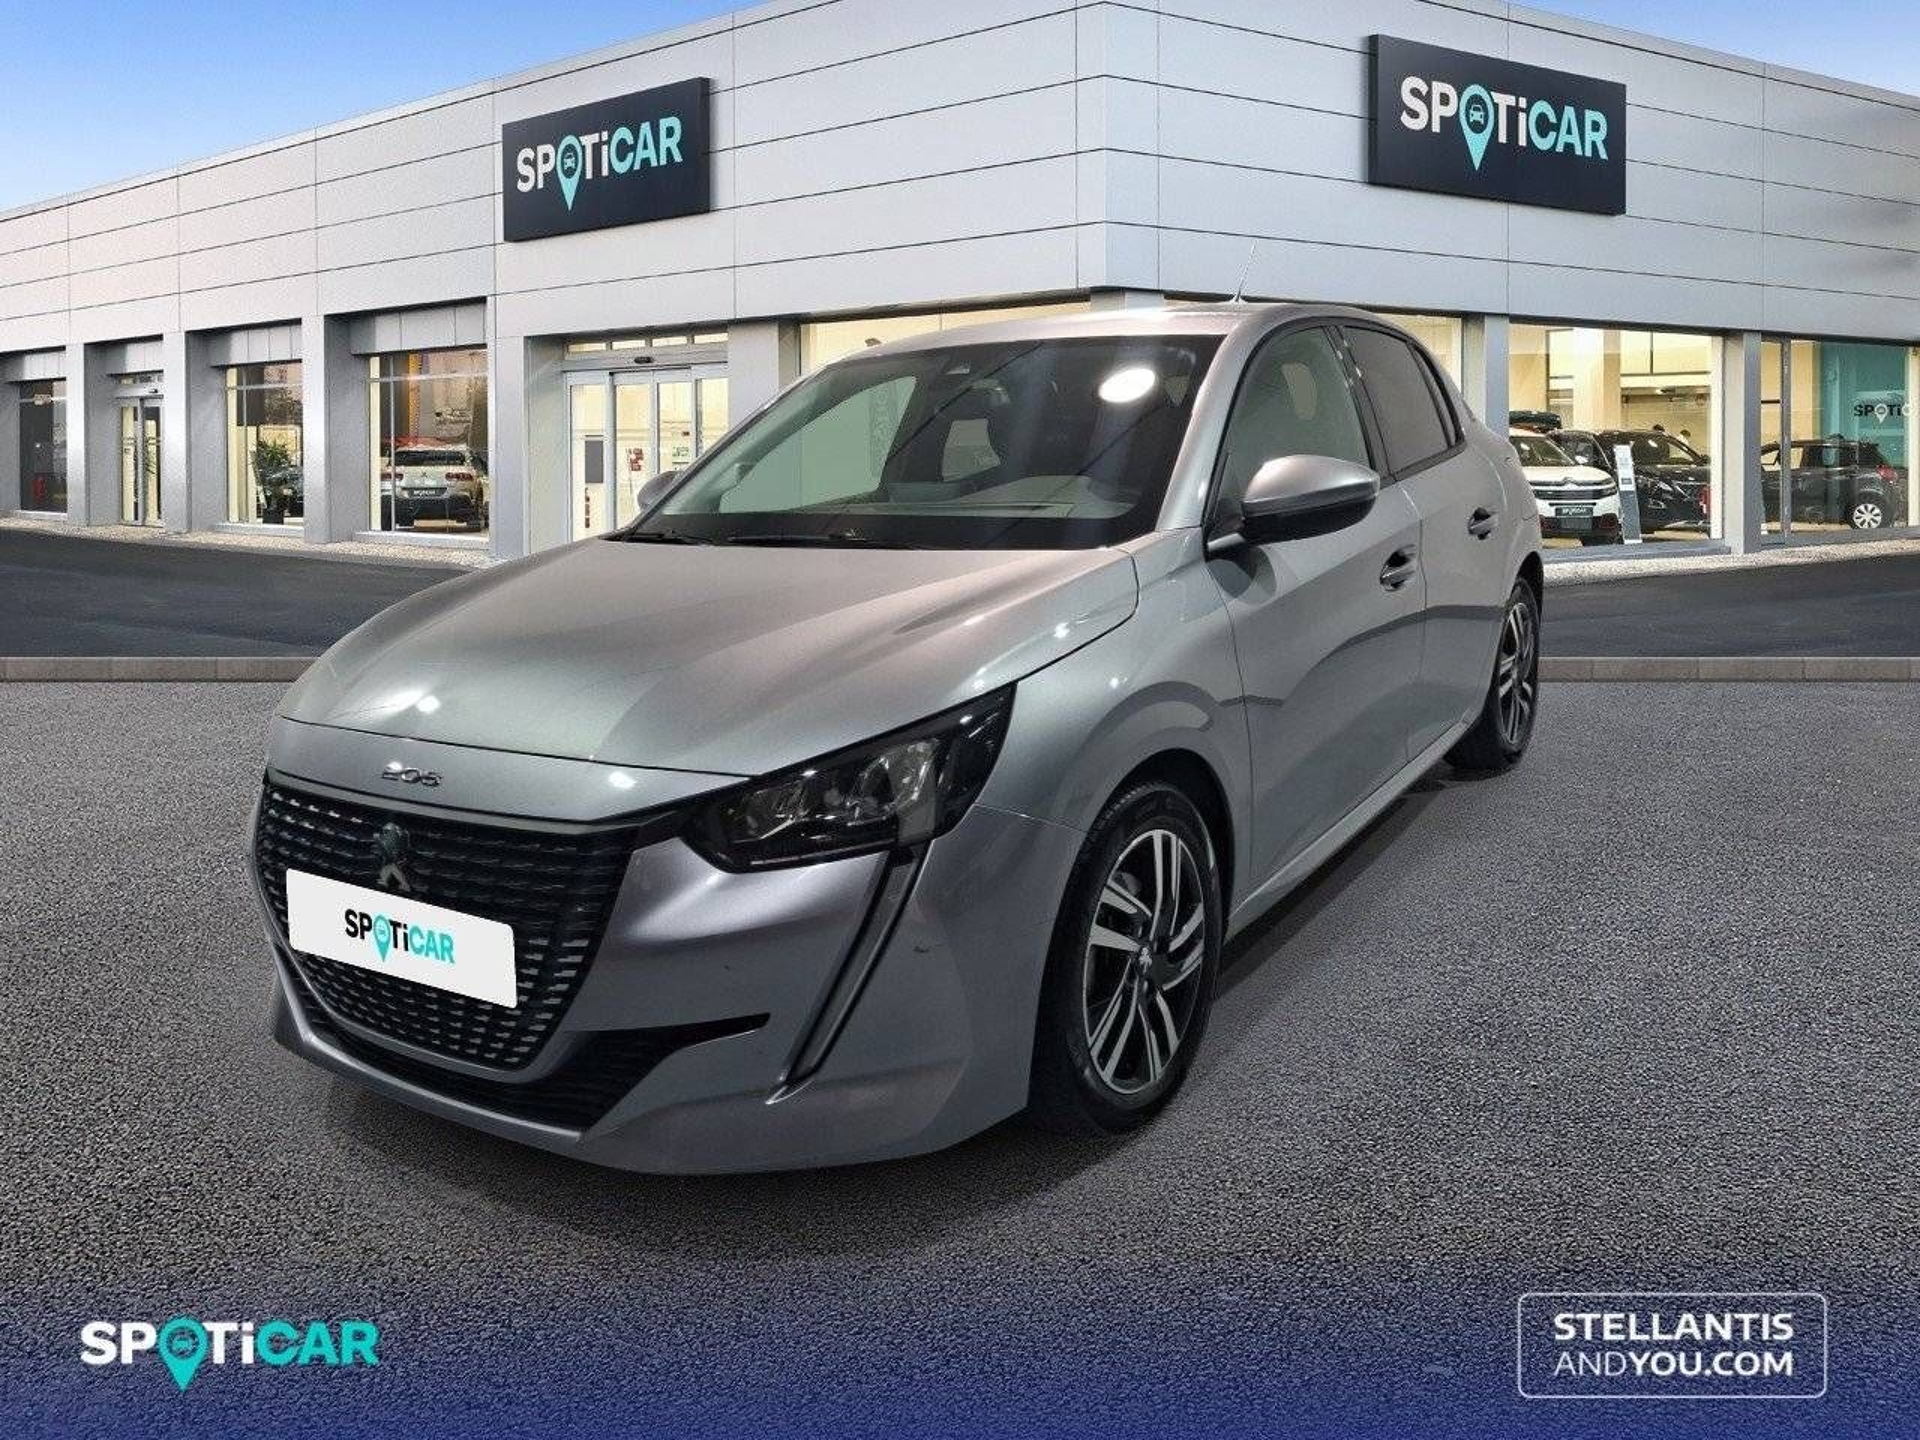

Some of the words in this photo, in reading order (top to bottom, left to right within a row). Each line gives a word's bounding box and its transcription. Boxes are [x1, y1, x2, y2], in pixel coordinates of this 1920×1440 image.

[516, 116, 683, 211] SPOTiCAR
[1400, 76, 1609, 171] SPOTiCAR
[344, 908, 455, 963] SPOTiCAR
